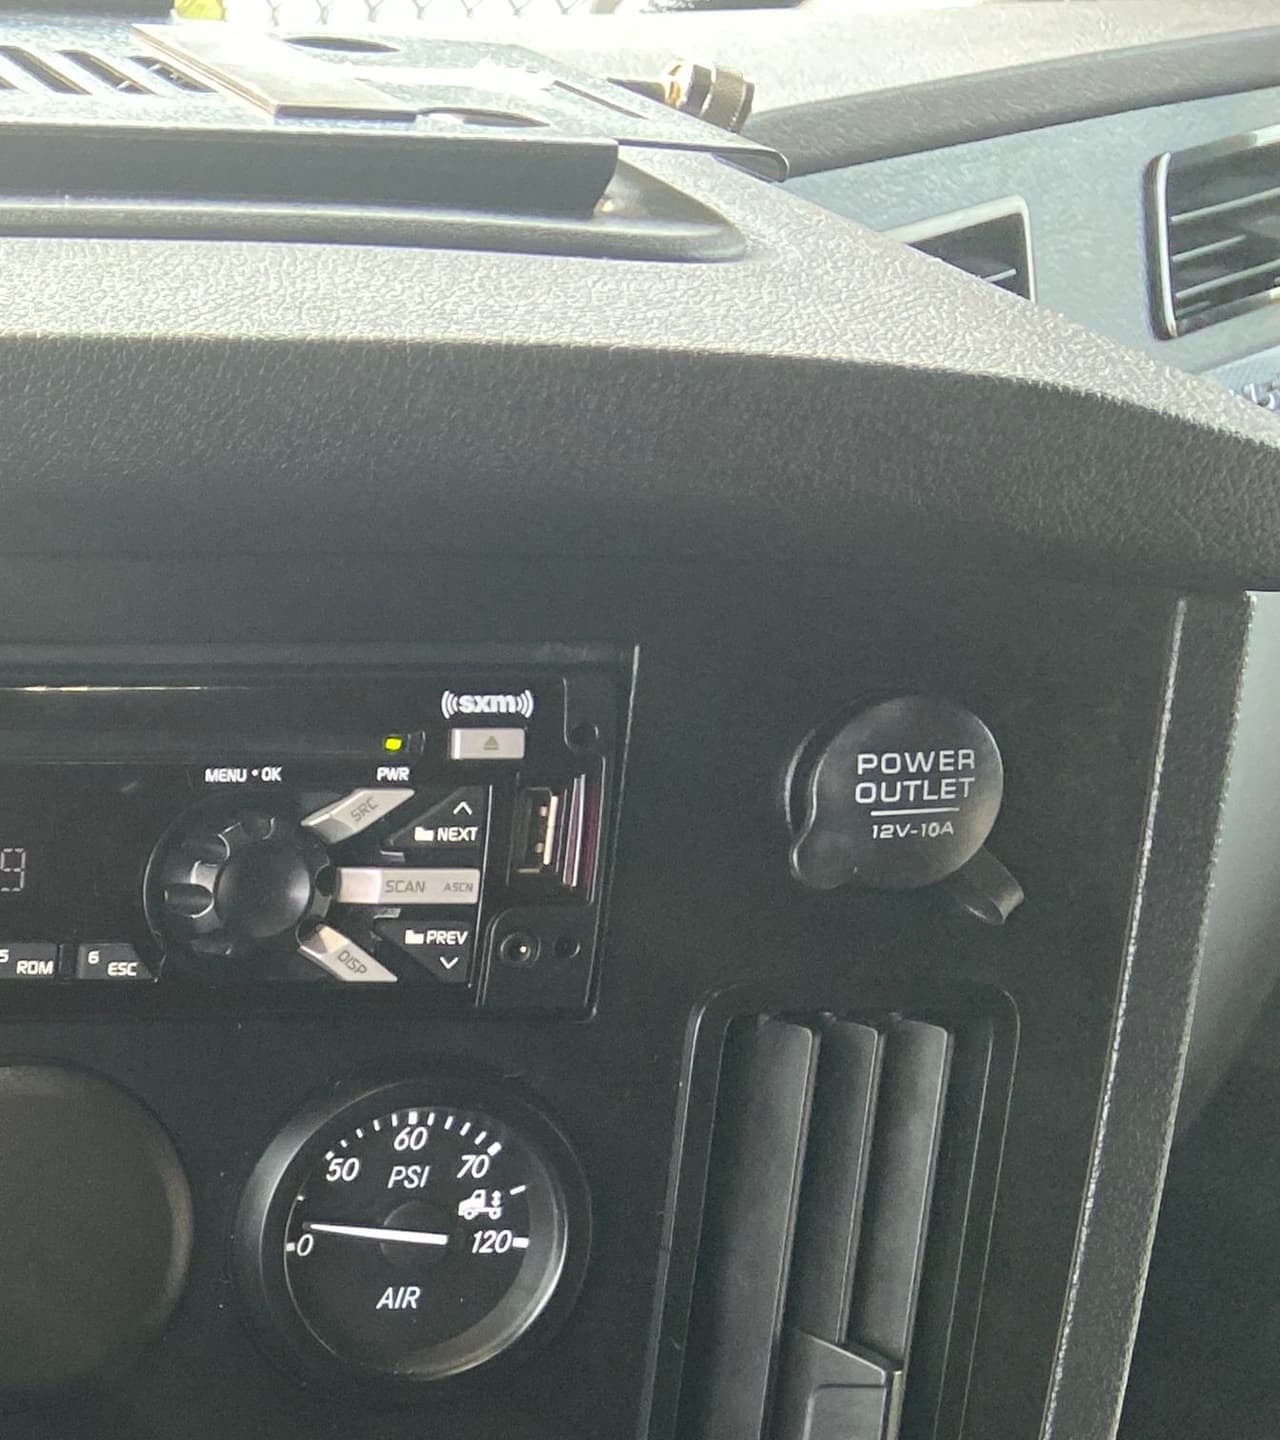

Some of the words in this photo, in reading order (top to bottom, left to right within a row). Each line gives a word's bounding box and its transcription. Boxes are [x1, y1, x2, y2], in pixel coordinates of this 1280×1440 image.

[857, 750, 976, 775] POWER
[204, 768, 248, 783] MENU
[261, 767, 282, 782] OK
[377, 767, 410, 782] PWR
[855, 777, 976, 804] OUTLET
[351, 796, 379, 822] SRC
[437, 826, 478, 842] NEXT
[871, 821, 955, 839] 12V-10A
[385, 879, 426, 894] SCAN
[426, 929, 468, 945] PREV
[16, 960, 55, 975] RDM
[88, 950, 100, 965] 6
[337, 950, 369, 976] DISP
[108, 961, 138, 977] ESC
[393, 1127, 428, 1151] 60
[326, 1158, 360, 1182] 50
[388, 1166, 430, 1188] PSI
[456, 1155, 490, 1179] 70
[296, 1234, 314, 1257] 0
[471, 1230, 512, 1254] 120
[376, 1287, 421, 1309] AIR
